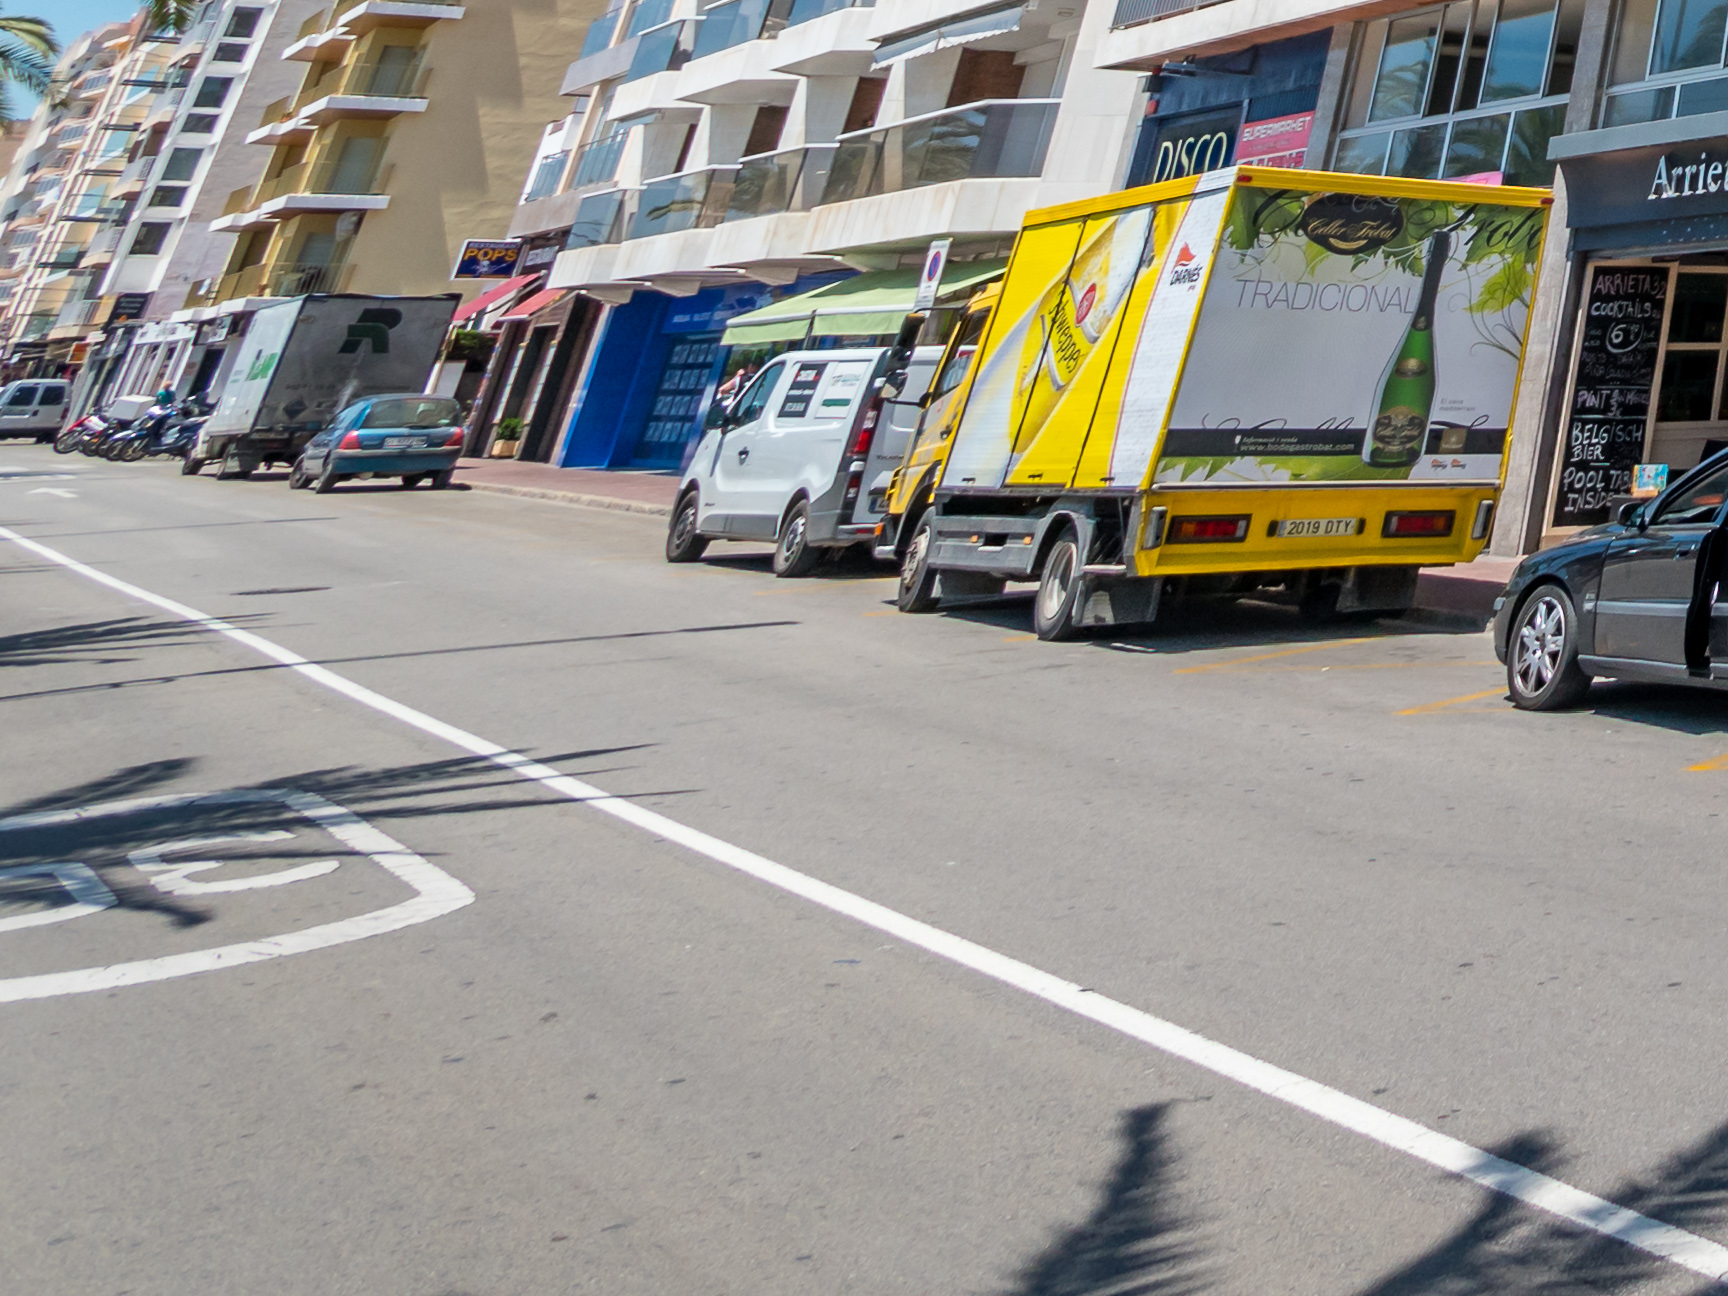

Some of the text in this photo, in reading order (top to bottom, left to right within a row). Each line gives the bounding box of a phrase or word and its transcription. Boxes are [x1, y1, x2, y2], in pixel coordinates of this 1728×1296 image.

[1242, 116, 1311, 142] SUPERMARKET
[1306, 218, 1396, 238] Celler Trobat
[463, 248, 518, 261] POPS
[1594, 273, 1651, 295] ARRIETA
[1235, 279, 1416, 314] TRADICIONAL
[1591, 299, 1652, 318] COCKTAILS
[1577, 390, 1610, 408] PINT
[1571, 422, 1643, 446] BELGISCH
[1240, 442, 1355, 452] www.bodegastrobat.com
[1570, 444, 1605, 462] BIER
[1563, 467, 1605, 491] POOL
[1287, 519, 1352, 535] 2019 DTY
